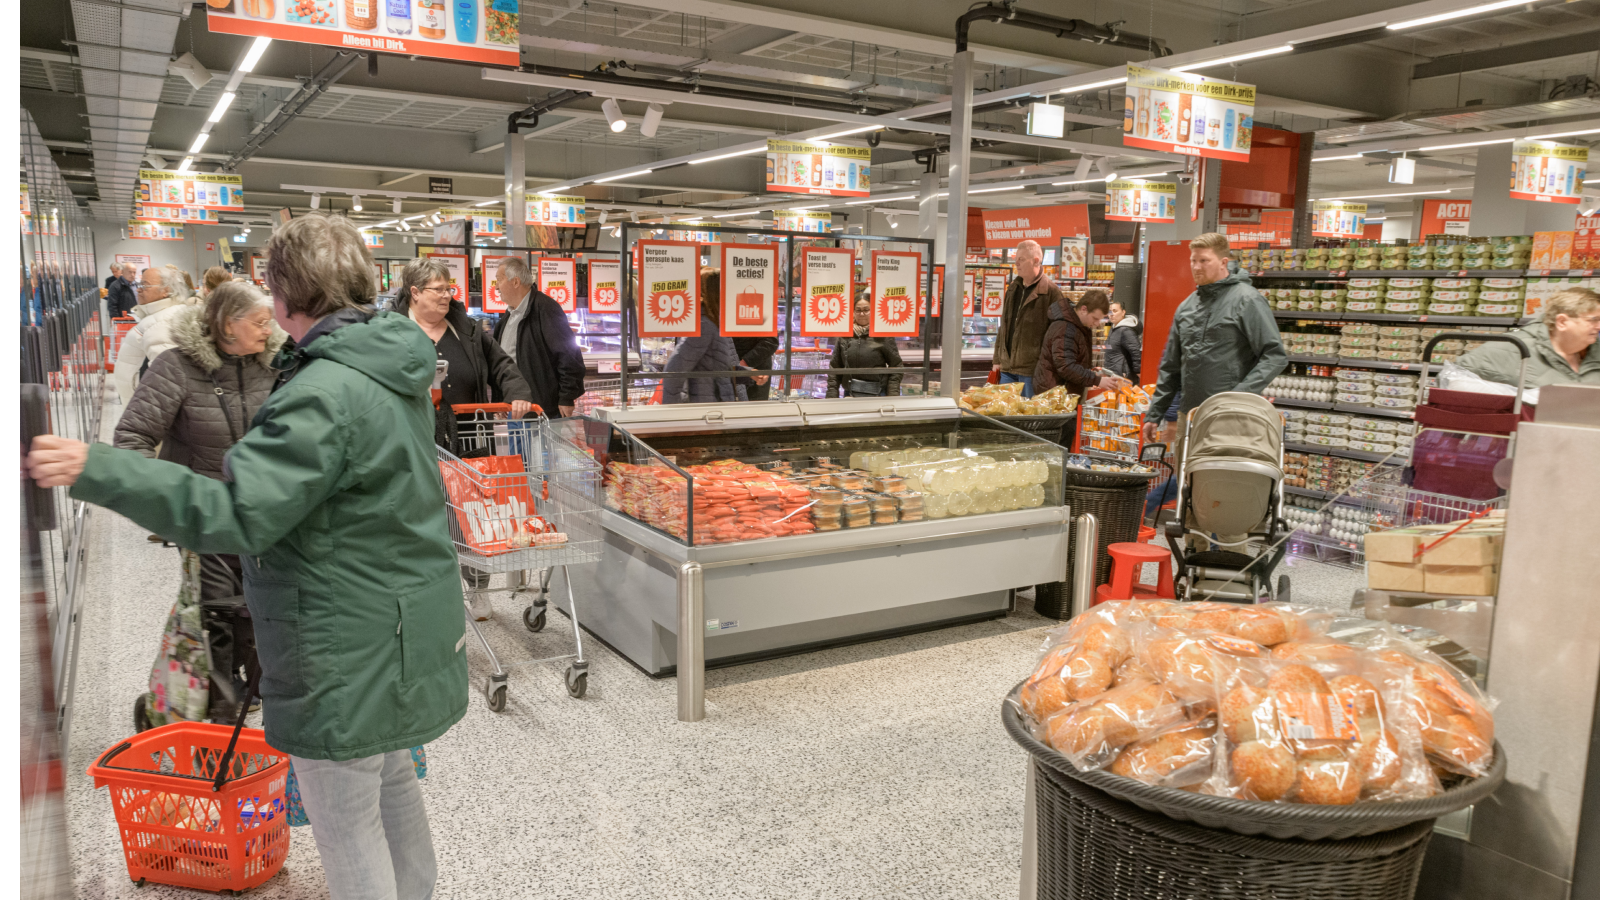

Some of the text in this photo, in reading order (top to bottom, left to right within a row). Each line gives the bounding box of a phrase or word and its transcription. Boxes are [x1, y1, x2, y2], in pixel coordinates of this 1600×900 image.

[342, 34, 407, 51] Alleen bij Dirk.
[1156, 76, 1194, 92] Dirk-merken
[1196, 83, 1210, 93] voor
[1211, 85, 1222, 94] een
[1224, 85, 1254, 99] Dirk-prijs.
[846, 148, 870, 156] Dirk-prijs.
[1436, 203, 1471, 218] ACTI
[984, 218, 1030, 230] Kiezen voor Dirk
[1576, 218, 1600, 230] CTI
[986, 227, 1052, 240] is kiezen voor voordeel
[1240, 231, 1275, 241] Nederland
[733, 256, 768, 267] De beste
[736, 268, 764, 278] acties!
[653, 281, 687, 291] 150 GRAM
[891, 288, 906, 296] LITER
[550, 288, 566, 303] 99
[599, 289, 615, 303] 99
[658, 294, 684, 318] 99
[739, 304, 760, 319] Dirk
[818, 298, 840, 319] 99
[269, 774, 285, 796] Dirk
